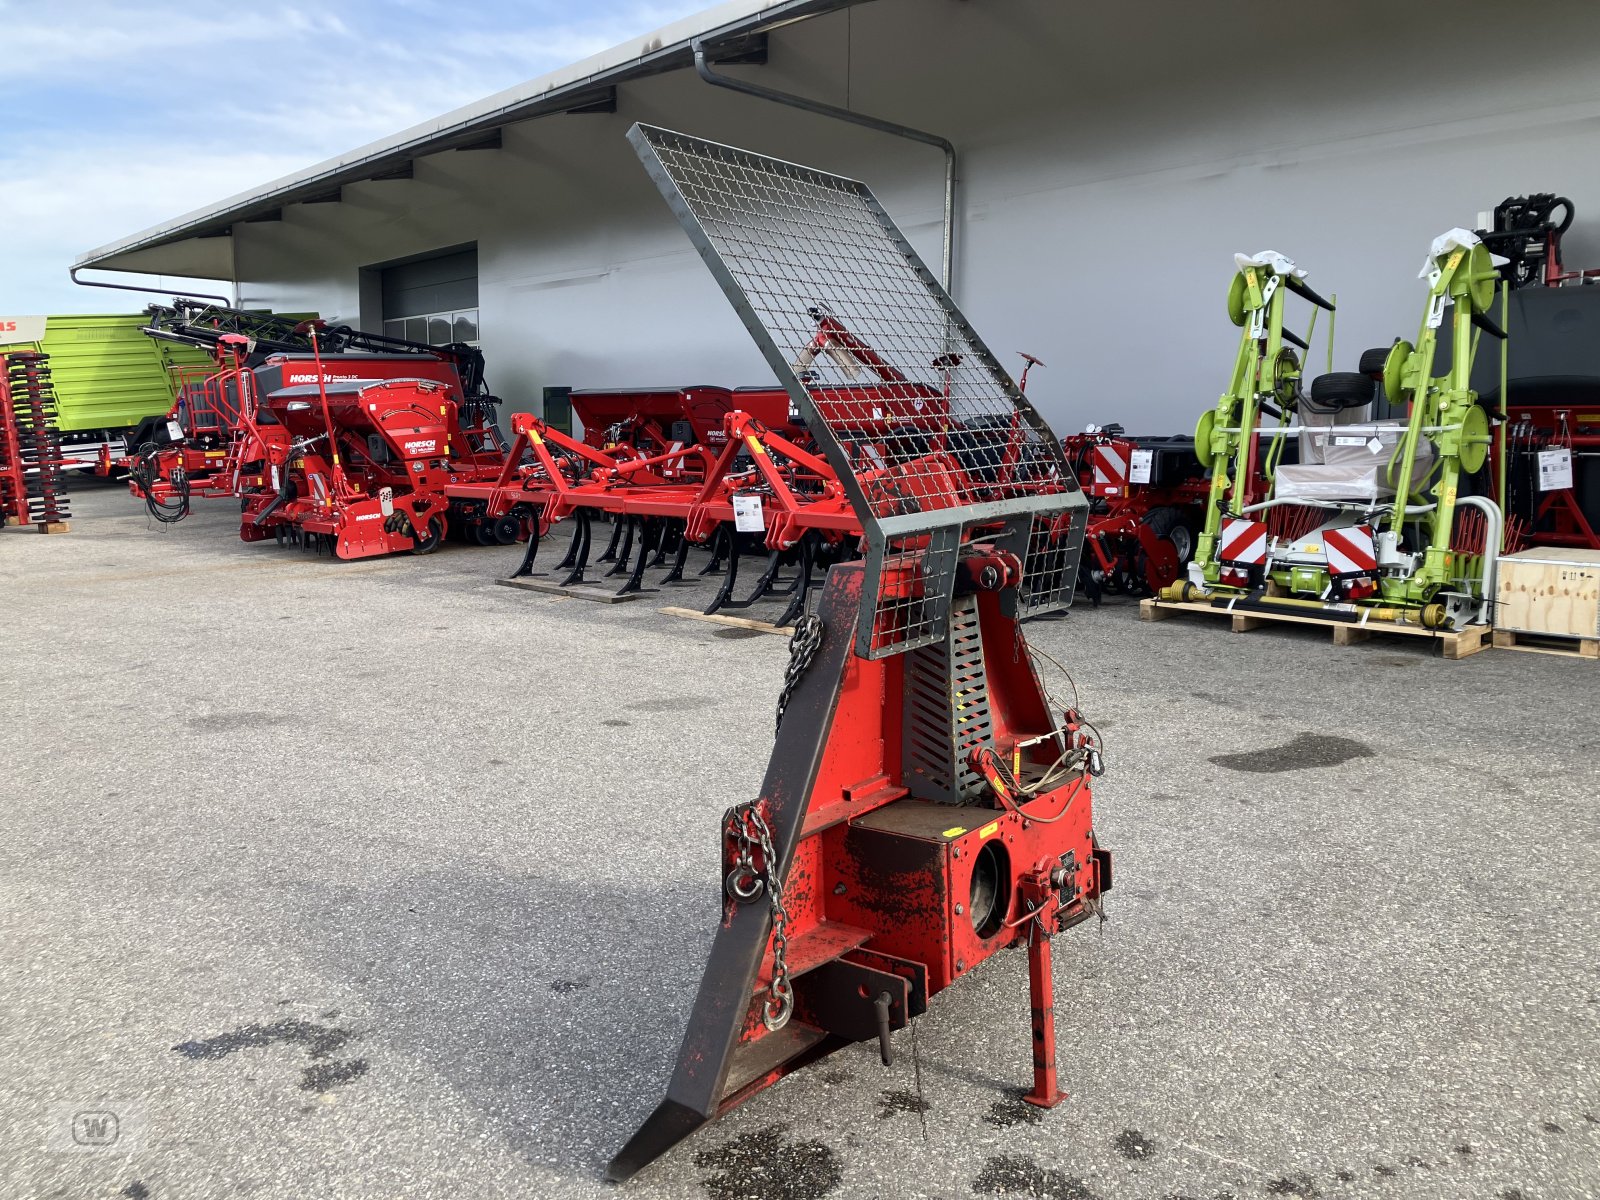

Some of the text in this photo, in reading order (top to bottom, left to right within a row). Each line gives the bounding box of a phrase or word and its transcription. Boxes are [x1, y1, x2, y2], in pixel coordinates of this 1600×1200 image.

[289, 374, 332, 383] HORSH
[404, 439, 436, 449] HORSCH
[355, 512, 381, 522] HORSCH
